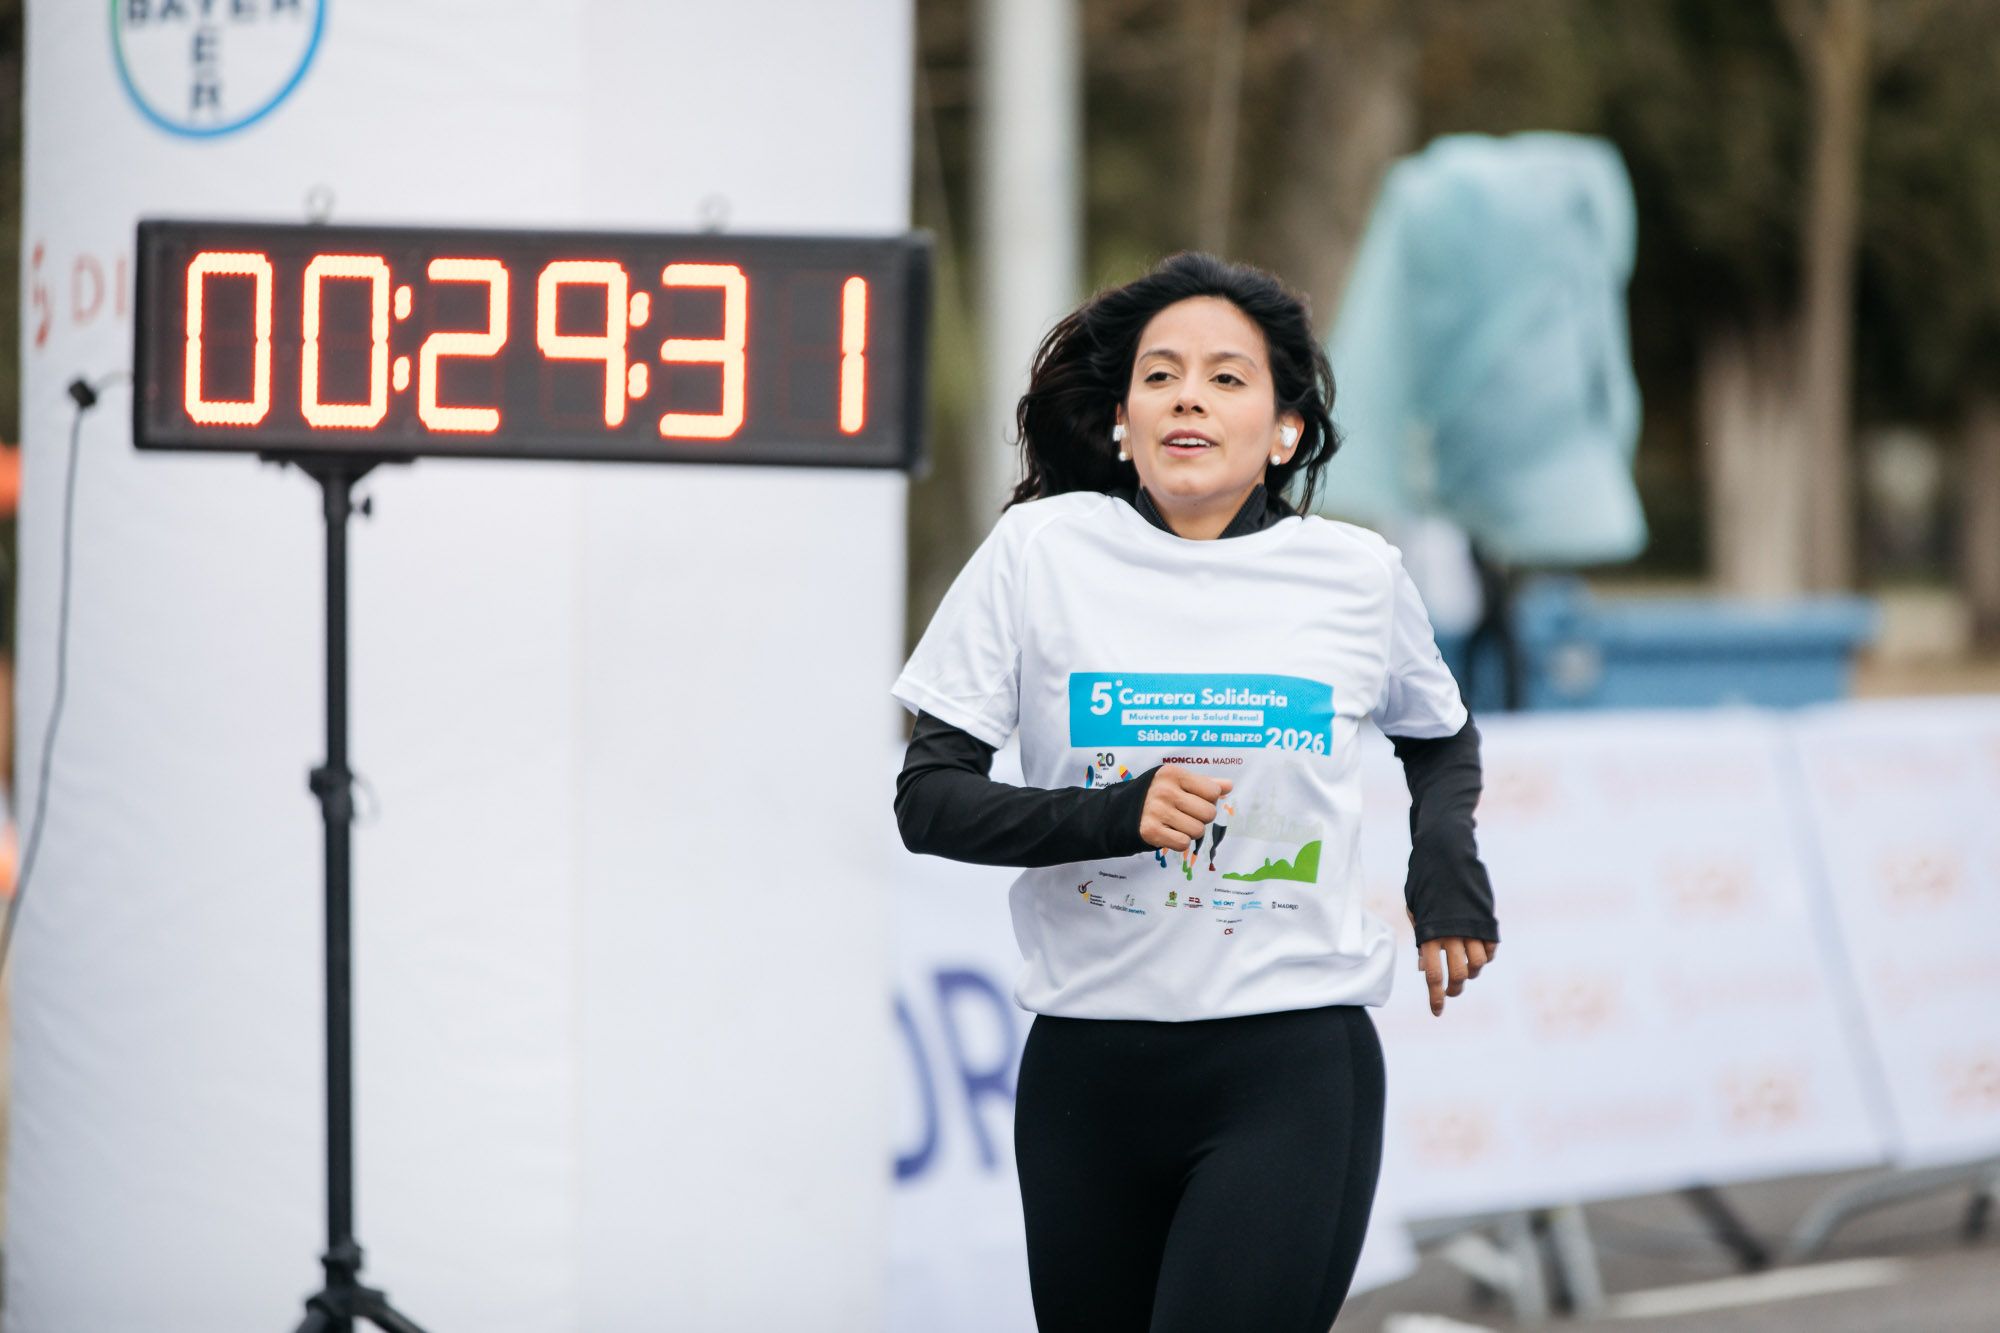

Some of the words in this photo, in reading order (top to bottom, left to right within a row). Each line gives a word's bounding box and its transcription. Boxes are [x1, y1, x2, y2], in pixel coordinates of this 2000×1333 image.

[1118, 687, 1196, 705] Carrera
[1201, 688, 1288, 708] Solidaria
[1172, 714, 1187, 722] por
[1203, 713, 1230, 721] Salud
[1232, 713, 1259, 721] Renal
[1137, 729, 1187, 742] Sábado
[1190, 730, 1199, 742] 7
[1201, 730, 1218, 742] de
[1221, 733, 1263, 743] marzo
[1265, 727, 1326, 754] 2026
[1096, 752, 1115, 767] 20
[1162, 757, 1210, 765] MONCLOA
